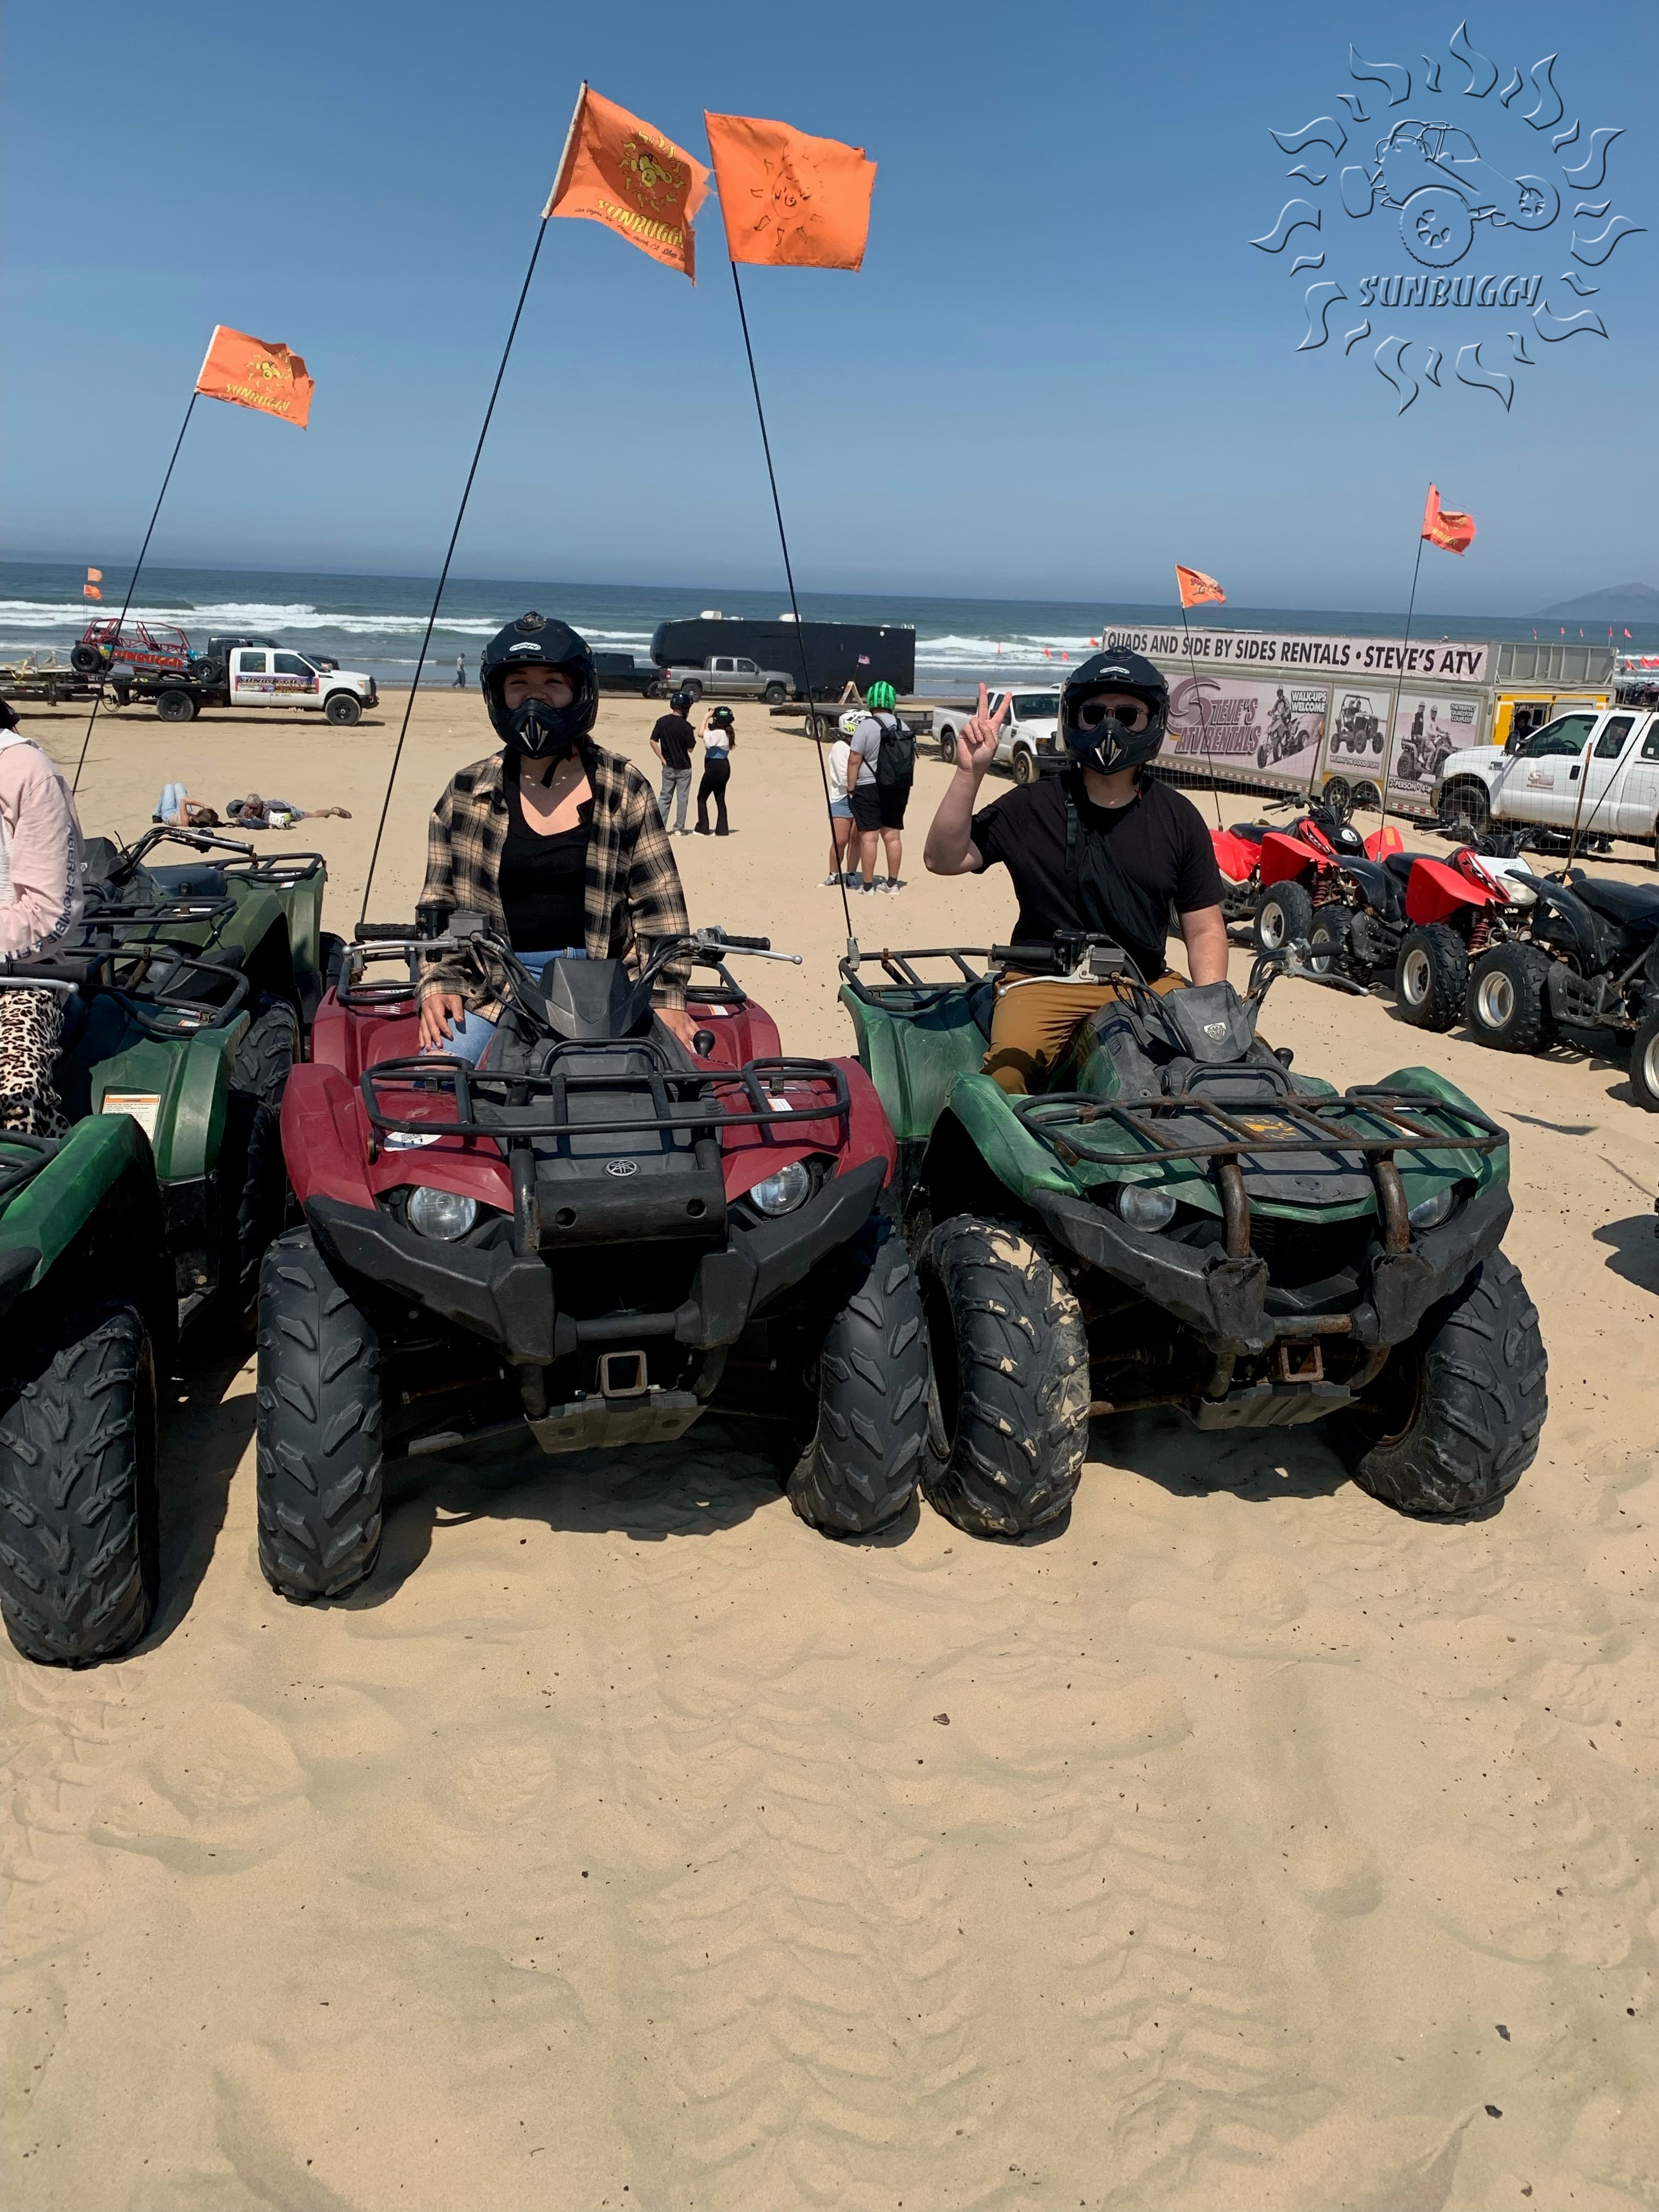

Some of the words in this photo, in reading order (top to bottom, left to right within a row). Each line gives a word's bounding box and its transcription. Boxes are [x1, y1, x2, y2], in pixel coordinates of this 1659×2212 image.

[1107, 632, 1148, 652] QUADS
[1150, 635, 1178, 653] AND
[1181, 636, 1210, 656] SIDE
[1214, 639, 1233, 658] BY
[1235, 639, 1276, 661] SIDES
[1280, 642, 1351, 666] RENTALS
[1363, 646, 1435, 672] STEVE'S
[1439, 650, 1483, 674] ATV
[1291, 690, 1327, 702] WALK-UPS
[1291, 702, 1326, 713] WELCOME
[1175, 725, 1205, 754] ATV
[1200, 725, 1262, 755] RENTALS
[1353, 759, 1367, 767] GOOD
[1389, 778, 1417, 791] 2-PERSON
[46, 825, 76, 944] ABERCROMBIE
